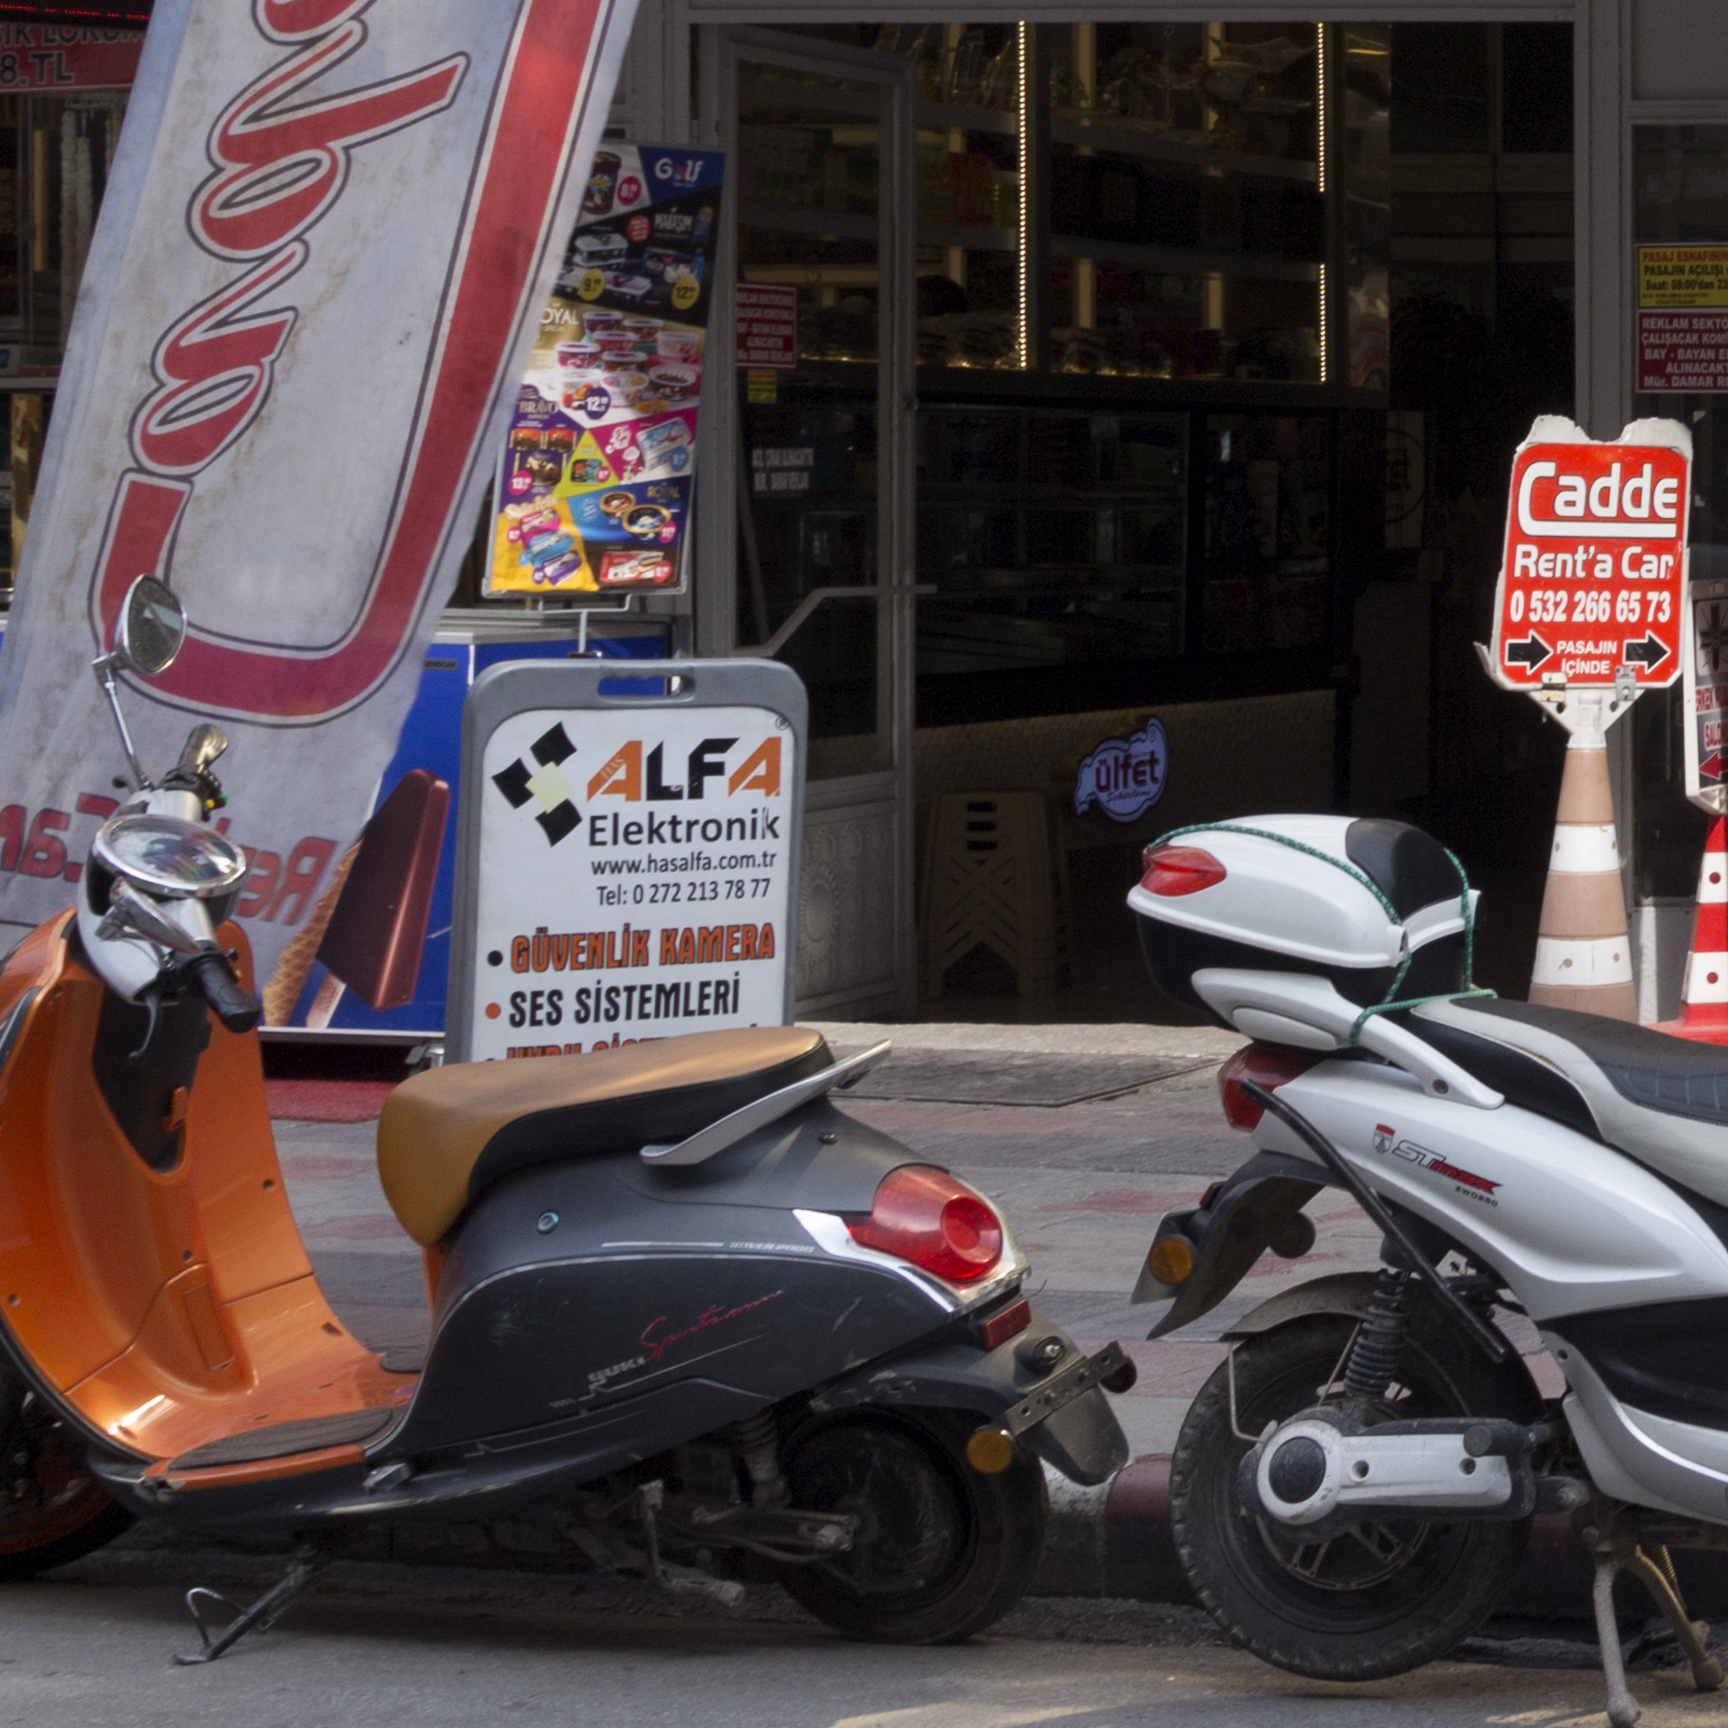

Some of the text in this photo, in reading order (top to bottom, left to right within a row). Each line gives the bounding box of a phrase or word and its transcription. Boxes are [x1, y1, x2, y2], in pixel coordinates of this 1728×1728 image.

[1641, 250, 1674, 262] PASAJ
[1643, 264, 1686, 276] PASAJIN
[540, 306, 580, 325] OYAL
[1641, 317, 1689, 329] REKLAM
[1641, 331, 1700, 347] ÇALIŞACAK
[1644, 348, 1667, 360] BAY
[1677, 348, 1716, 361] BAYAN
[1643, 376, 1669, 388] Mür.
[1671, 375, 1715, 388] DAMAR
[1517, 461, 1680, 539] Cadde
[1513, 543, 1675, 580] Rent'a Car
[1509, 589, 1671, 624] 0 532 266 65 73
[1556, 640, 1618, 655] PASAJIN
[1561, 656, 1611, 677] İÇİNDE
[587, 736, 782, 803] ALFA
[589, 807, 780, 847] Elektronik
[591, 850, 777, 876] www.hasalfa.com.tr
[597, 877, 772, 908] Tel: 0 272 213 78 77
[510, 922, 777, 974] GÜVENLİK KAMERA
[508, 970, 741, 1029] SES SİSTEMLERİ
